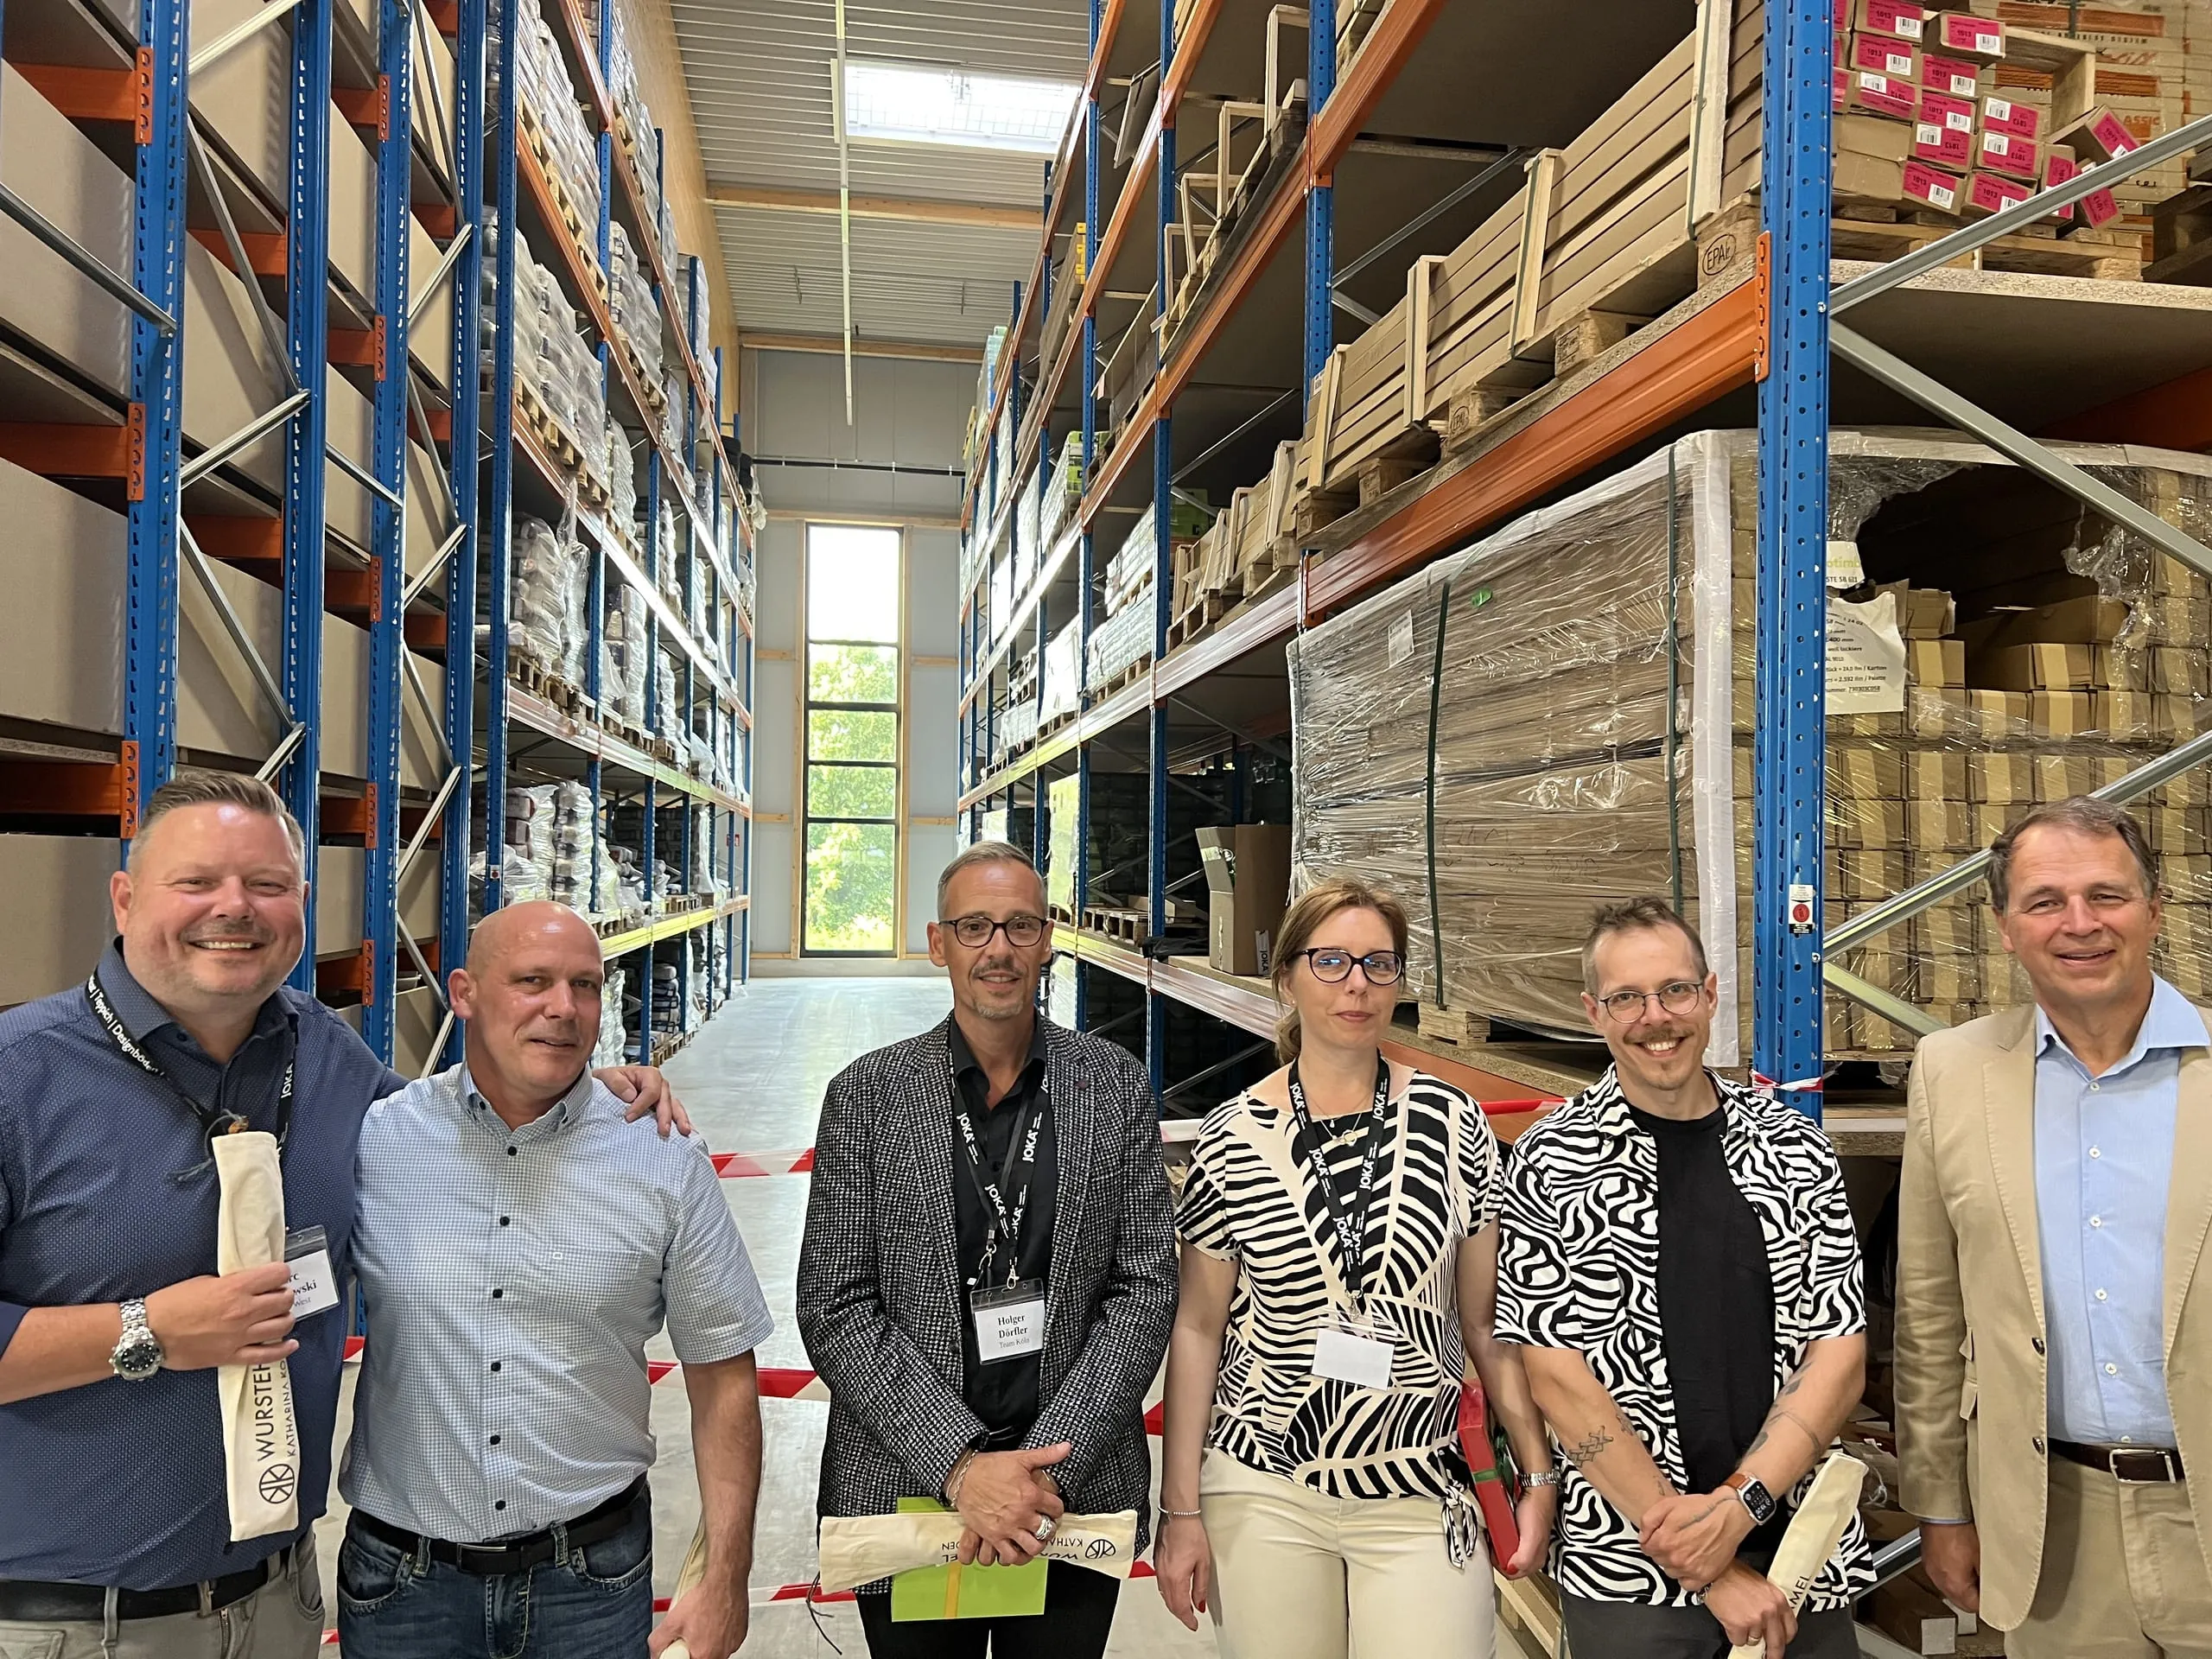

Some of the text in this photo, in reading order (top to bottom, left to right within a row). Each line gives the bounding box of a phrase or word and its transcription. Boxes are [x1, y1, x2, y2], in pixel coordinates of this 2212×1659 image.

[1867, 48, 1882, 57] 1013
[1929, 105, 1943, 115] 1013
[1260, 950, 1269, 971] JOKA
[94, 992, 114, 1024] Teppich
[281, 1062, 294, 1099] JOKA
[1290, 1082, 1306, 1110] JOKA
[1372, 1091, 1386, 1122] JOKA
[957, 1112, 976, 1143] JOKA
[1022, 1129, 1039, 1163] JOKA
[1308, 1147, 1329, 1176] JOKA
[1359, 1159, 1375, 1191] JOKA
[984, 1183, 1007, 1217] JOKA
[1332, 1216, 1354, 1249] JOKA
[293, 1279, 317, 1295] wski
[998, 1314, 1026, 1326] Holger
[998, 1326, 1028, 1338] Dörfler
[999, 1337, 1030, 1349] Team Köln
[283, 1382, 296, 1458] KATHARINA
